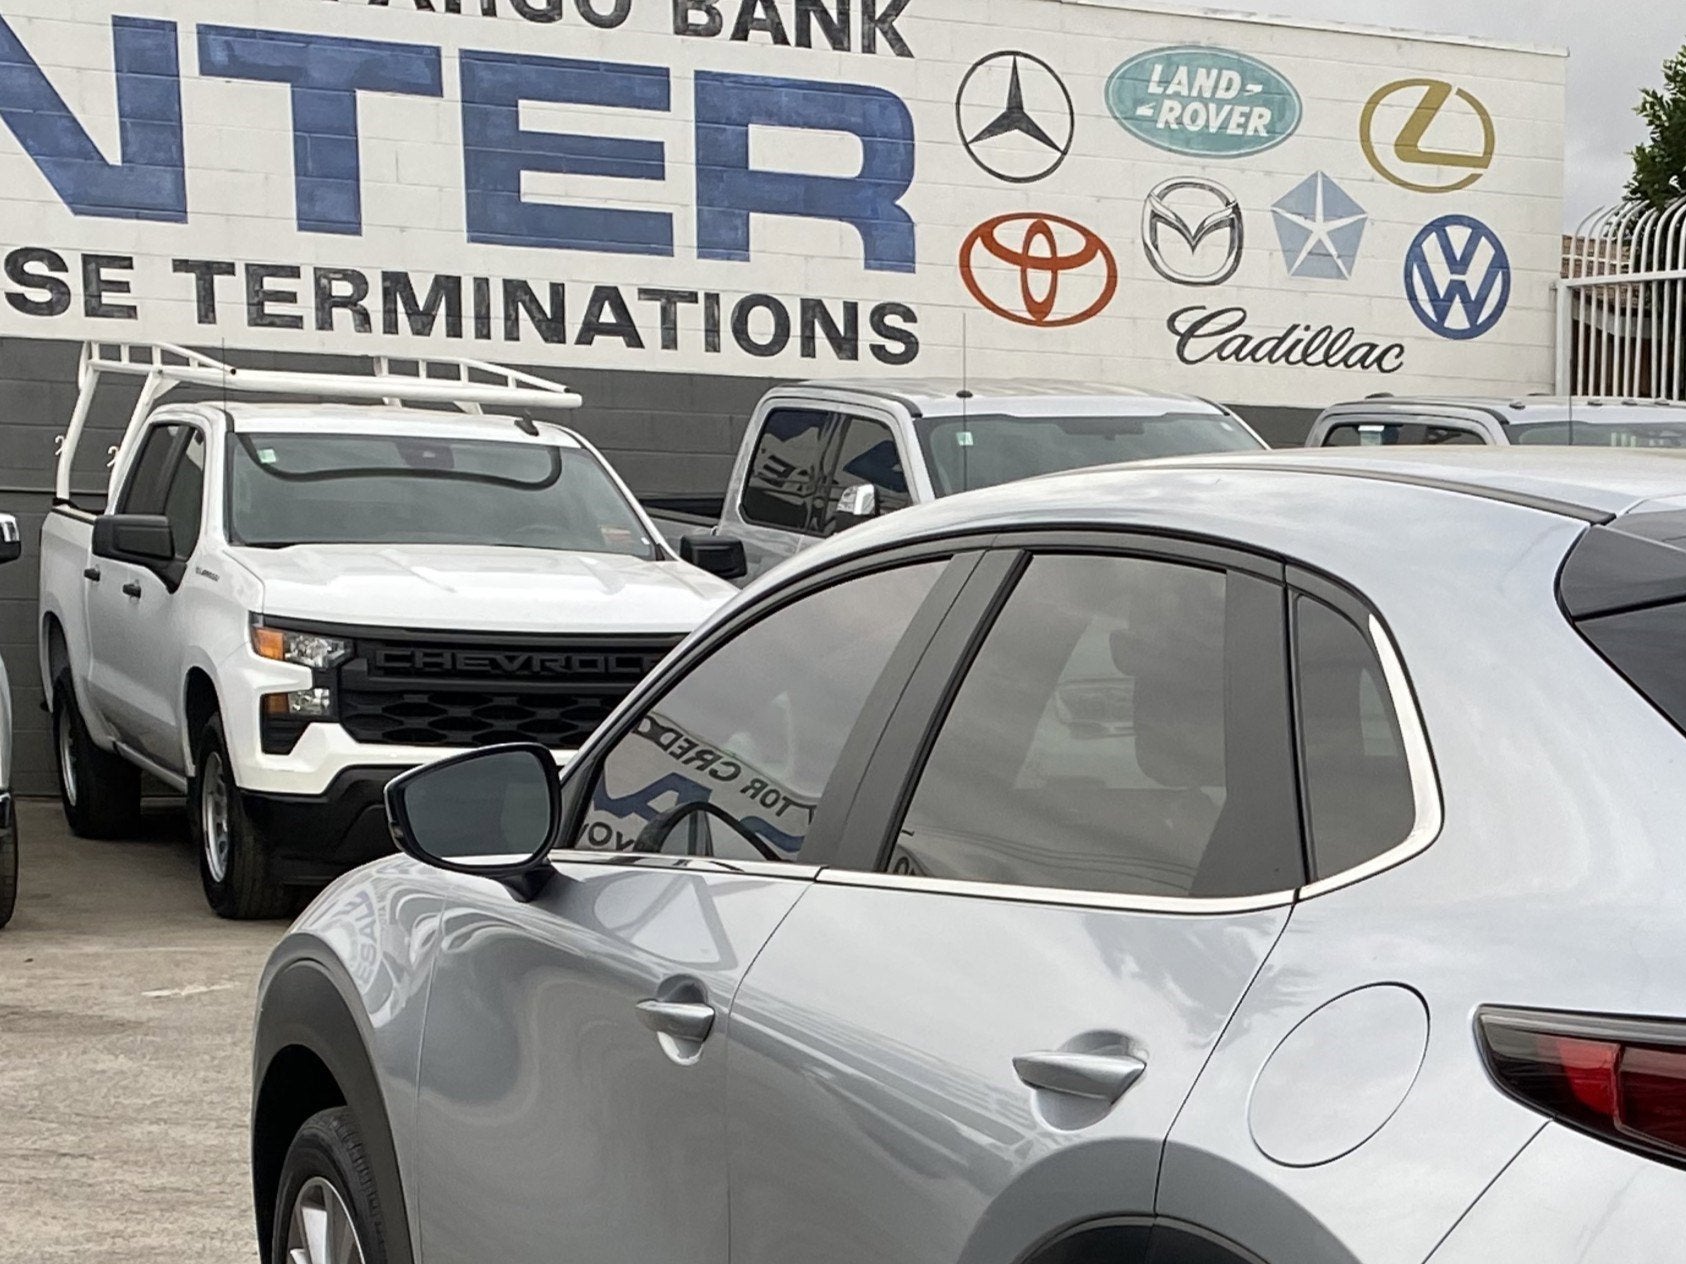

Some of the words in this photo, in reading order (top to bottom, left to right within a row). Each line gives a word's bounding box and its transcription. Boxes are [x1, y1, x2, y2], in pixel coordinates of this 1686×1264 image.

[0, 14, 917, 273] NTER
[3, 246, 138, 320] SE
[171, 257, 921, 366] TERMINATIONS
[1166, 304, 1405, 375] Cadillac
